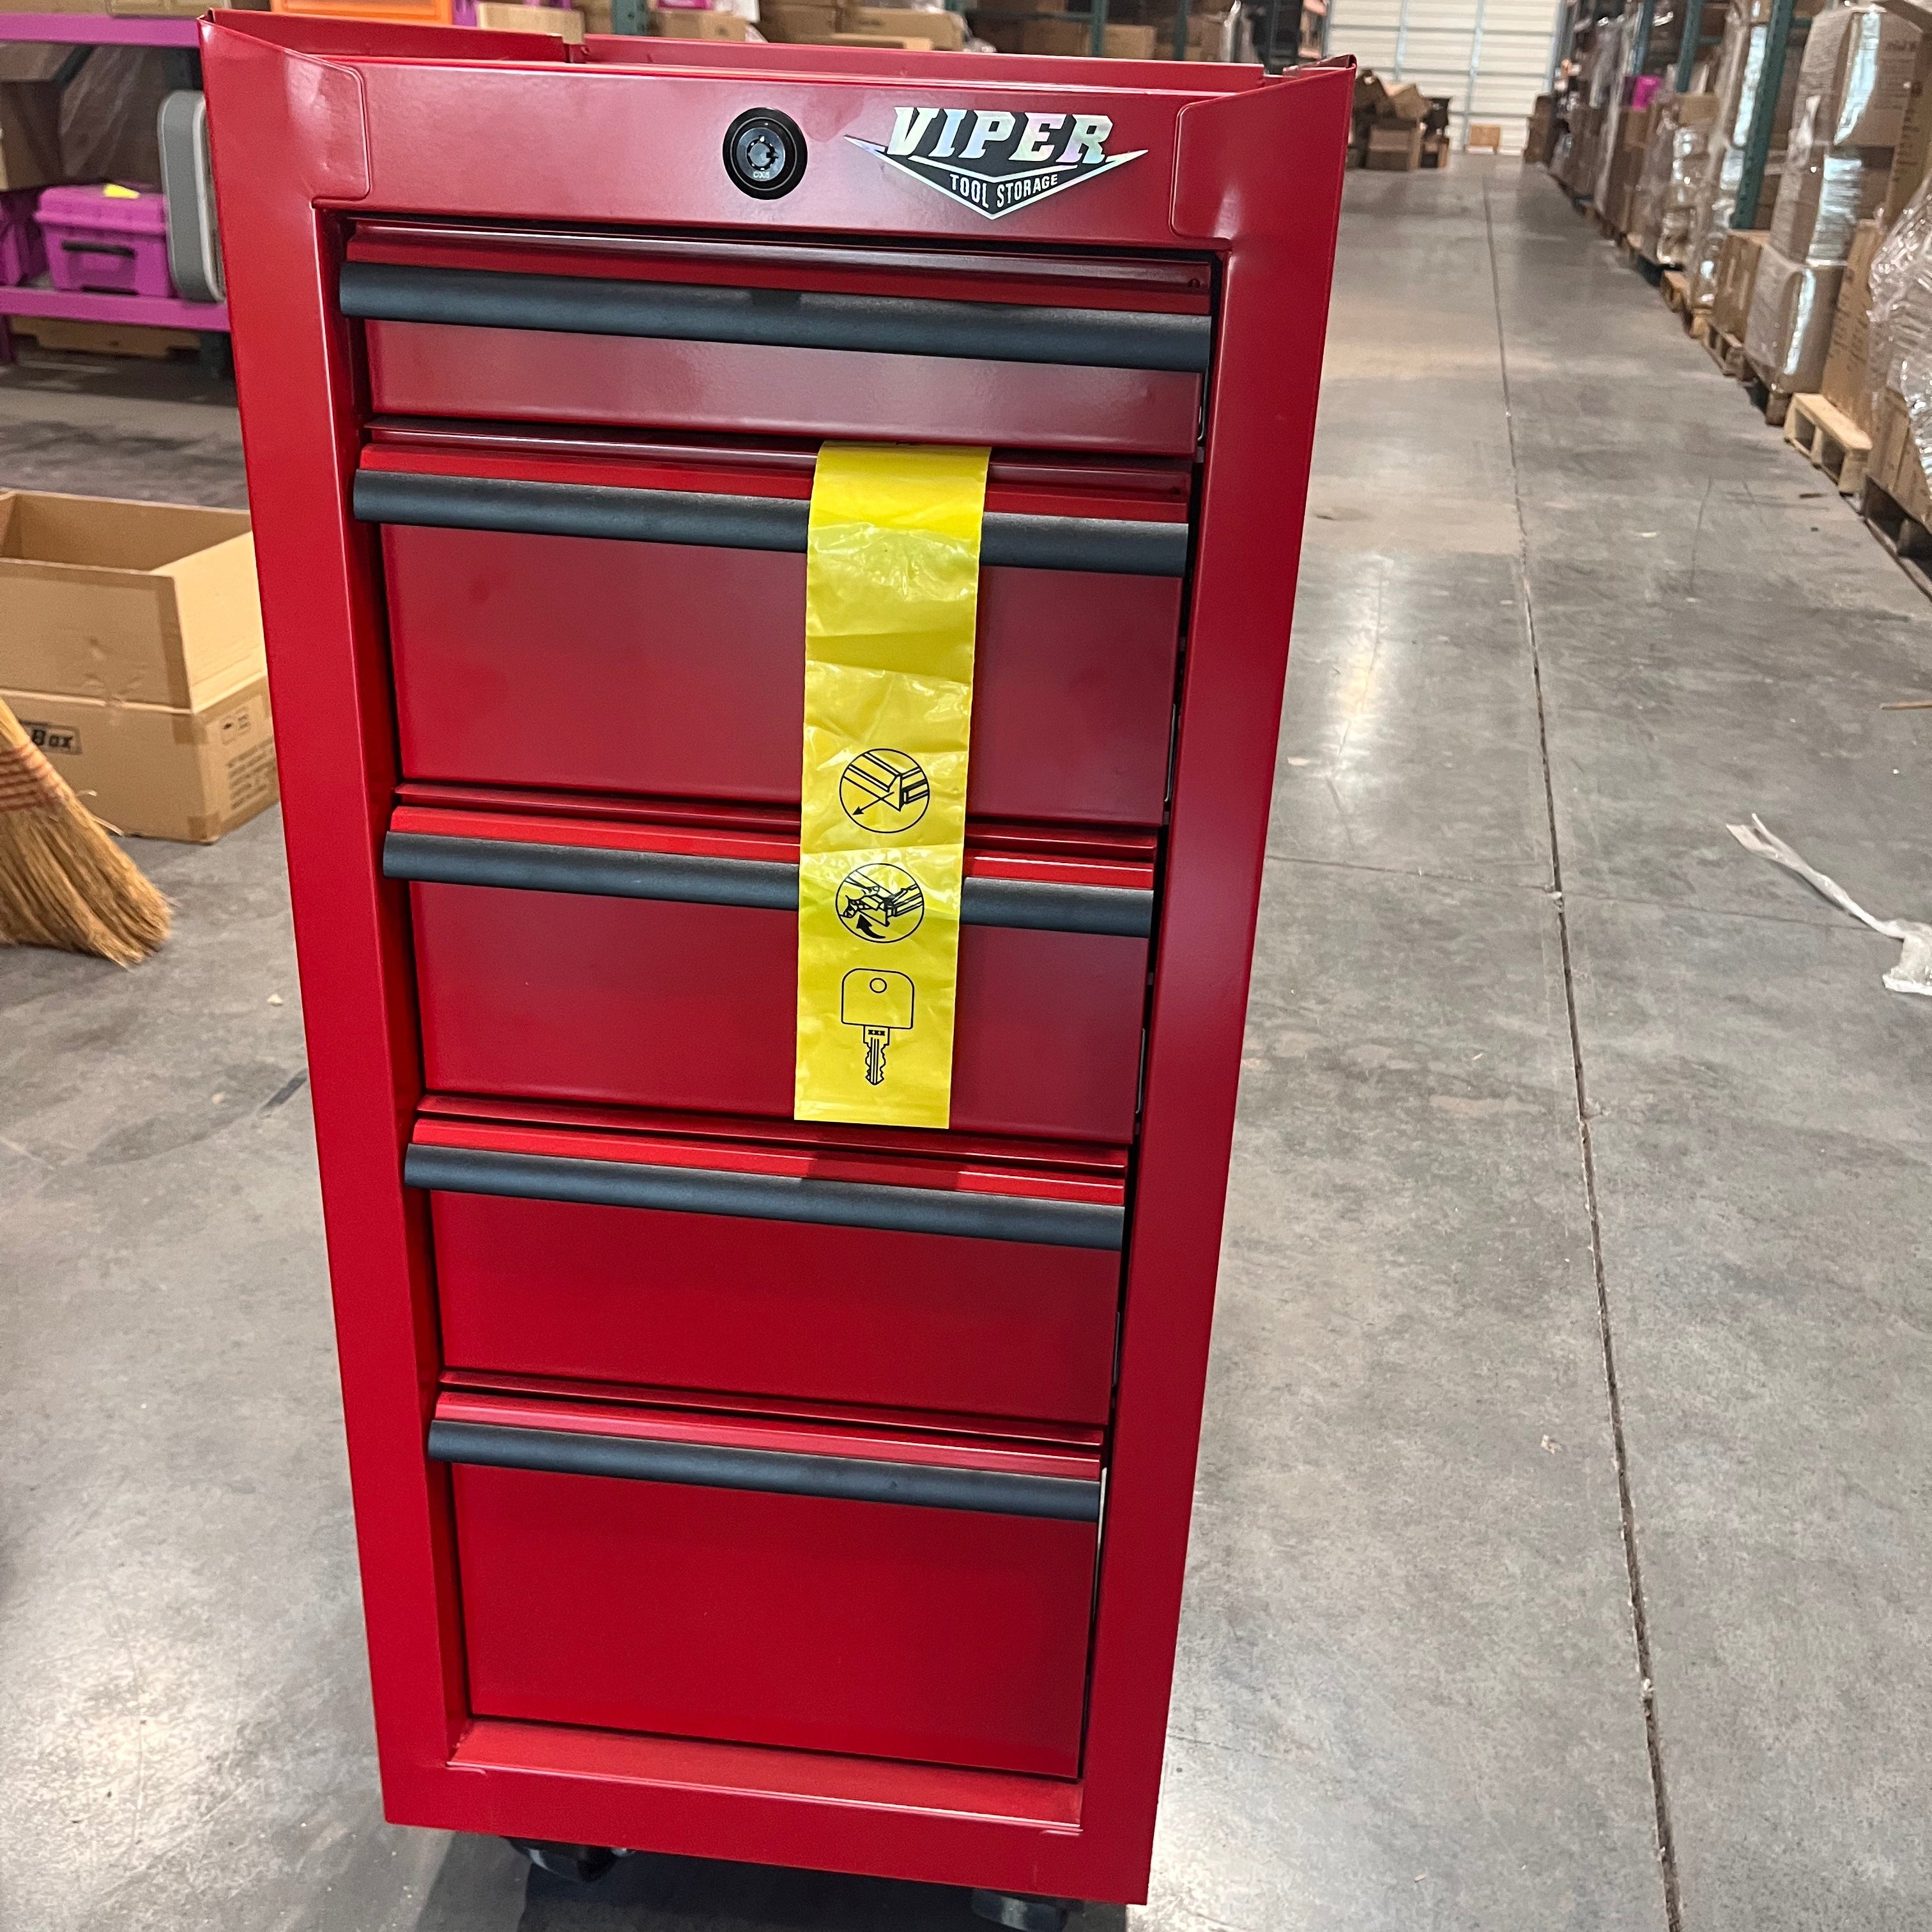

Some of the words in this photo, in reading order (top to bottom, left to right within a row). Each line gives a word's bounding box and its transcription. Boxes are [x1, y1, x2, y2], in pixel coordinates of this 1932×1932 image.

[887, 106, 1114, 164] VIPER
[949, 173, 989, 208] TOOL
[997, 174, 1058, 208] STORAGE
